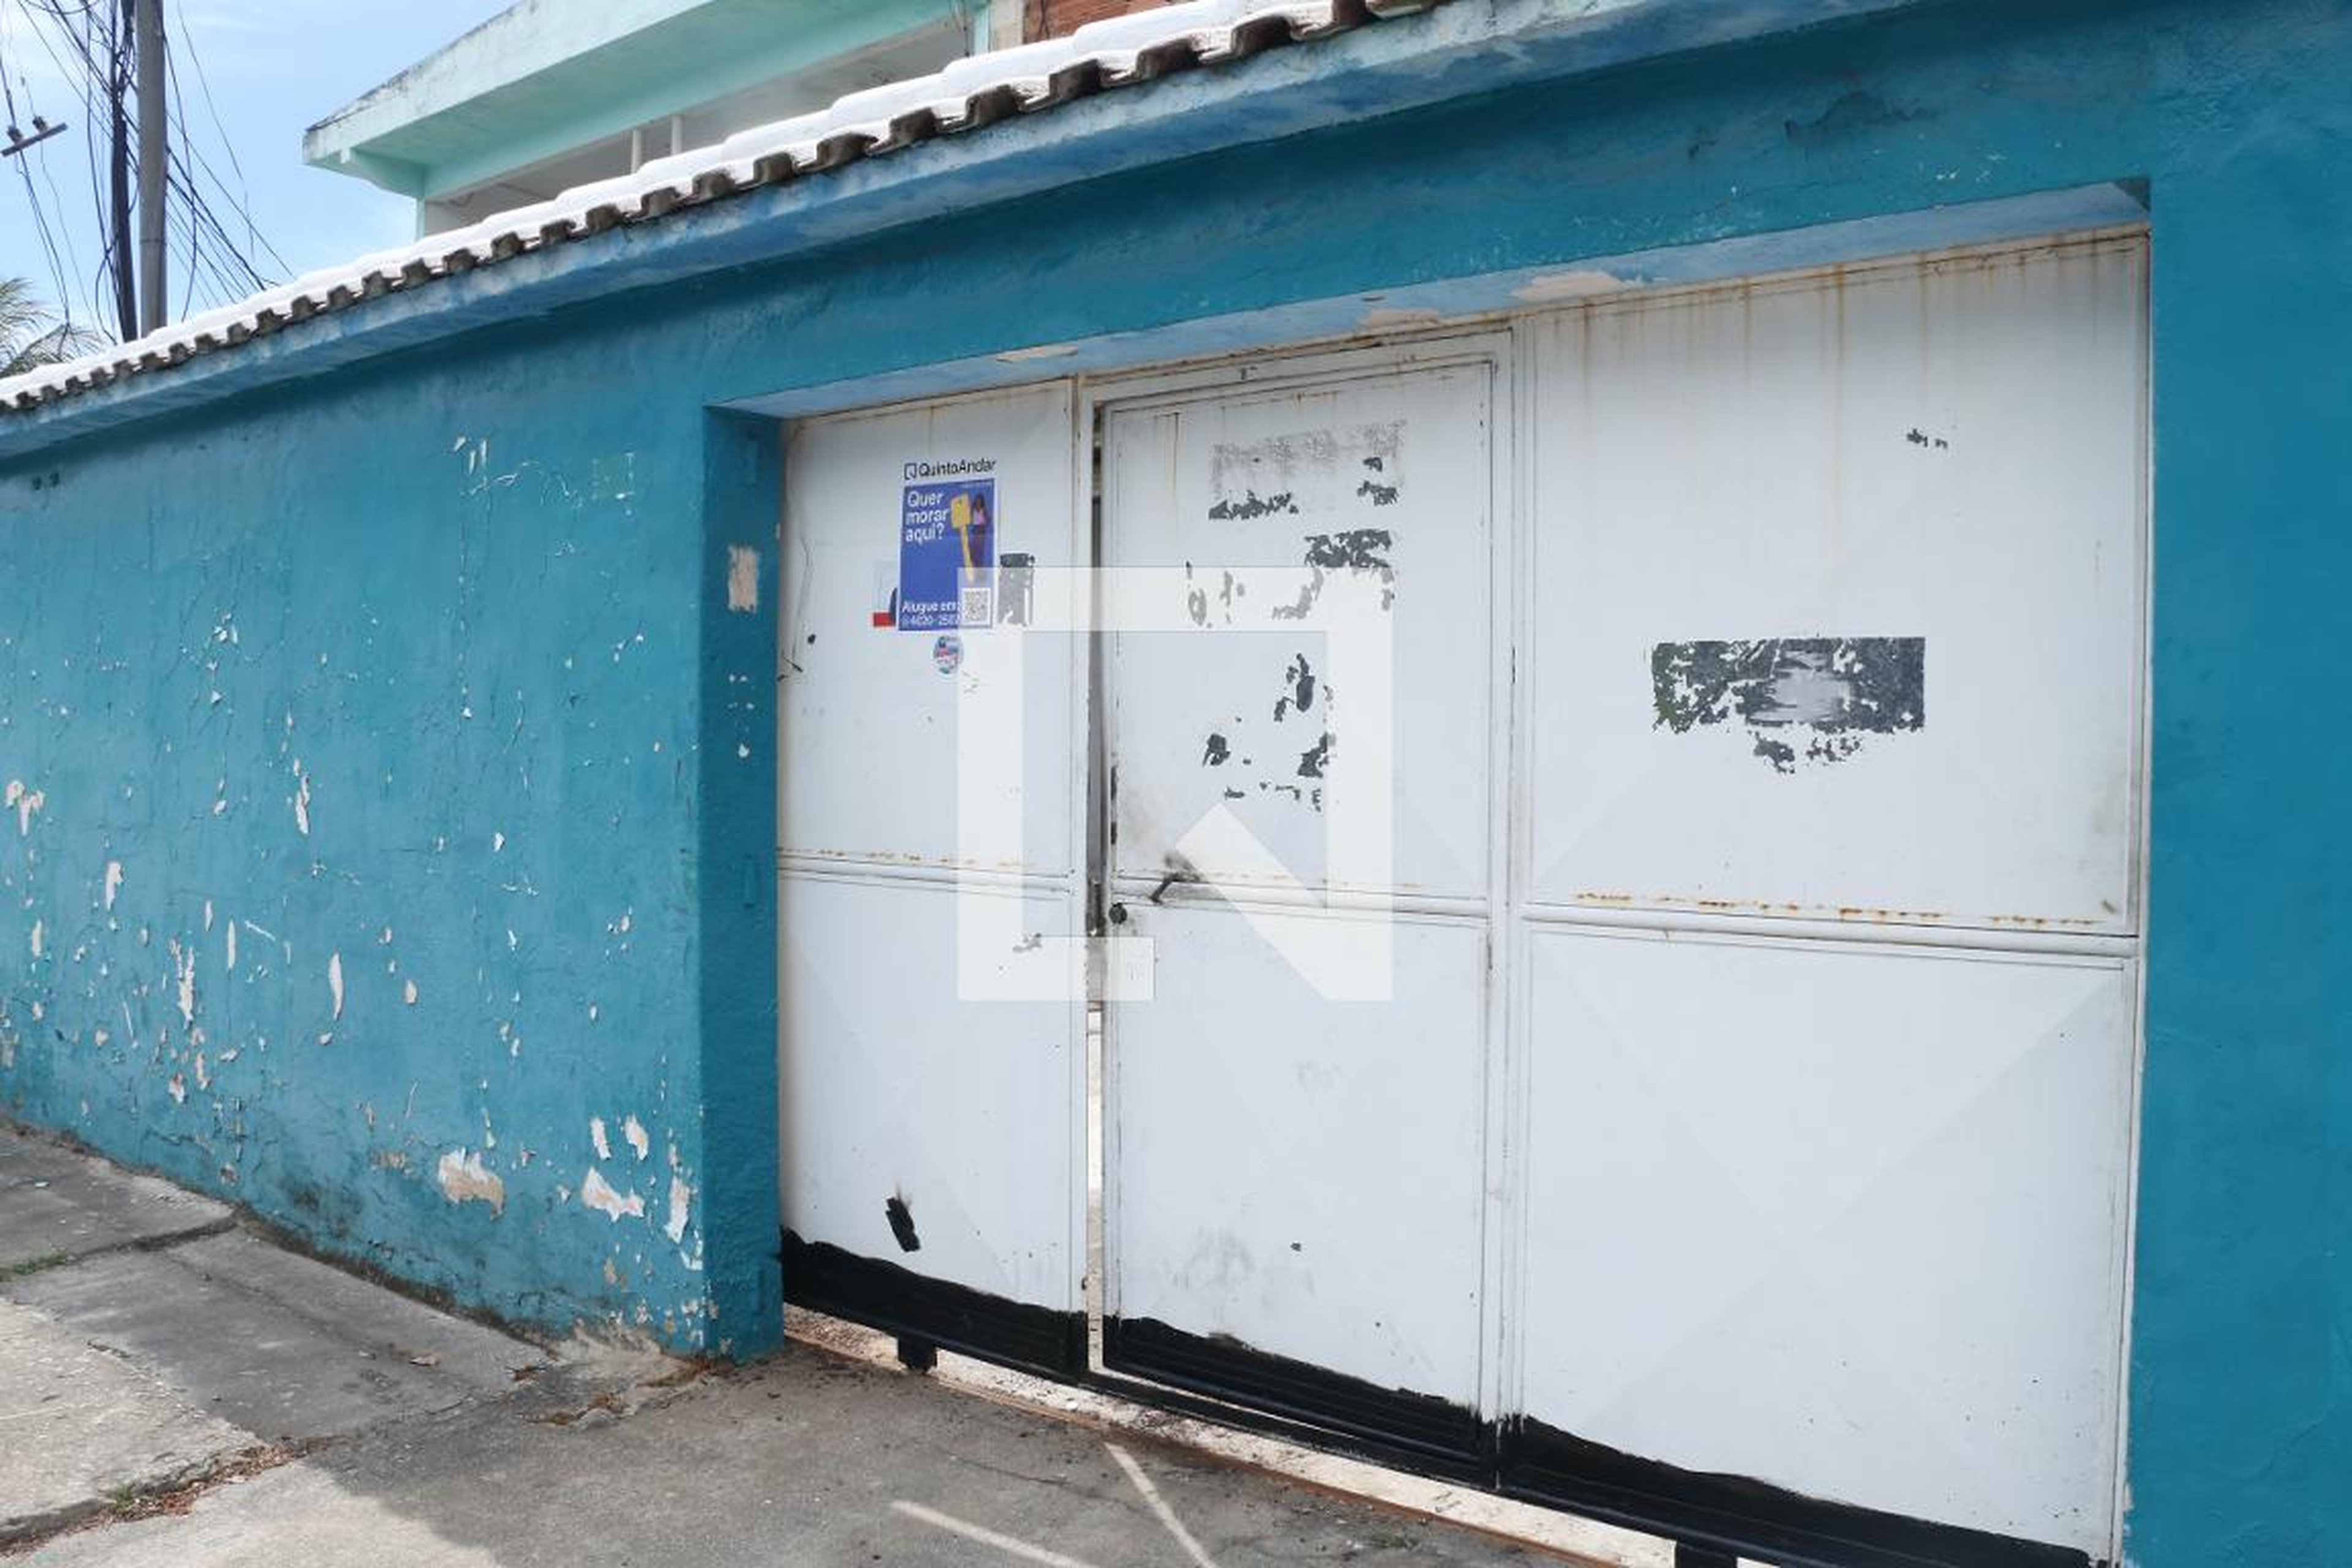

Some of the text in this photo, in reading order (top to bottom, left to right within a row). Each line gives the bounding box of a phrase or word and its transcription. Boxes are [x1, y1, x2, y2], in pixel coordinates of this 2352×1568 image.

[919, 458, 997, 477] QuintoAndar
[908, 491, 944, 507] Quer
[905, 509, 949, 525] morar
[905, 522, 944, 544] aqui?
[902, 601, 938, 614] Alugue
